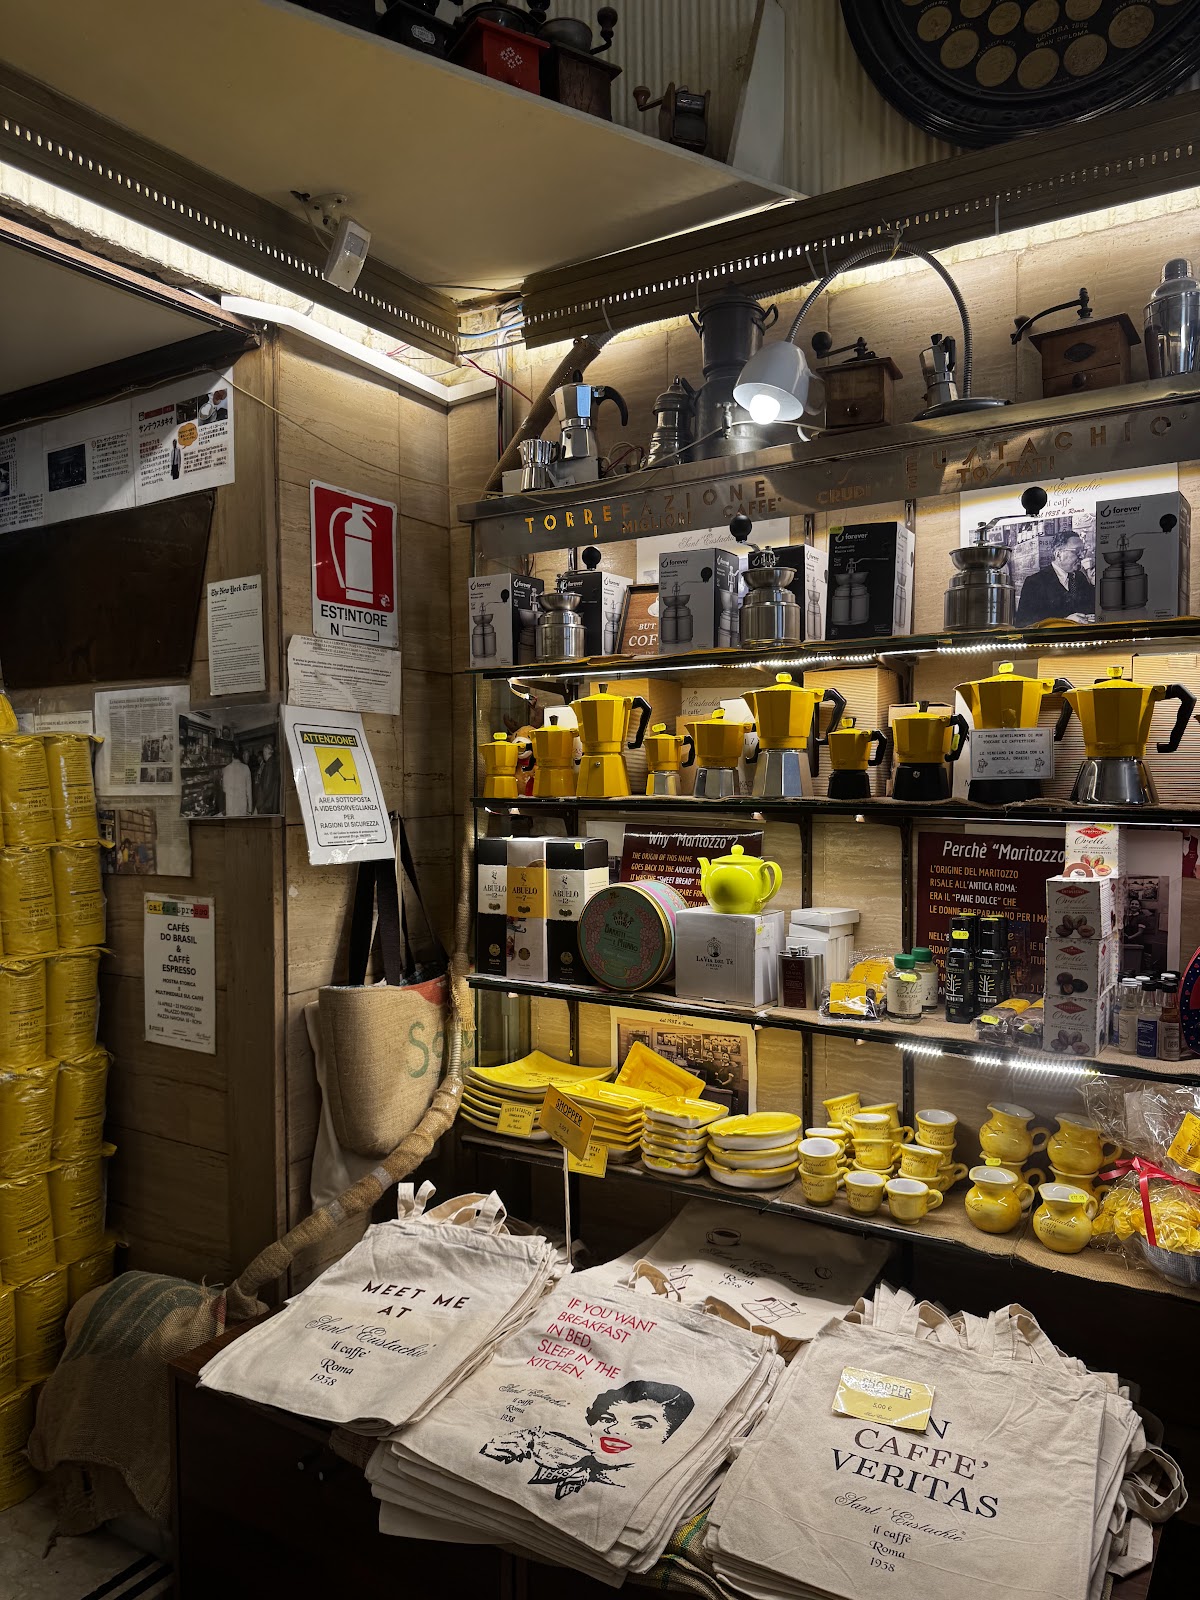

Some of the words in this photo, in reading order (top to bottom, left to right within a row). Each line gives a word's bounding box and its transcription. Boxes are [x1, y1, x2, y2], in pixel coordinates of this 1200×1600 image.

[524, 479, 767, 534] TORREFAZIONE
[905, 415, 1172, 474] EUSTACHIO
[621, 511, 692, 534] MIGLIORI
[816, 485, 872, 505] CRUDI
[956, 455, 1056, 484] TOSTATI
[1113, 506, 1141, 515] forever
[845, 532, 868, 540] forever
[210, 589, 220, 597] The
[219, 587, 230, 595] New
[230, 585, 242, 594] York
[242, 583, 258, 592] Times
[567, 579, 584, 588] forever
[320, 603, 388, 628] ESTINTORE
[330, 623, 340, 636] N
[638, 622, 656, 631] BUT
[628, 634, 659, 648] COF
[303, 732, 357, 746] ATTENZIONE!
[320, 804, 379, 812] VIDEOSORVEGLIANZA
[649, 831, 670, 849] Why
[1074, 835, 1105, 845] Ovelli
[942, 840, 988, 859] Perchè
[631, 851, 641, 860] THE
[641, 852, 659, 861] ORIGIN
[659, 853, 665, 861] OF
[666, 854, 678, 862] THIS
[678, 855, 693, 863] NAME
[631, 862, 643, 871] GOES
[644, 863, 657, 872] BACK
[658, 864, 664, 872] TO
[664, 864, 675, 872] THE
[674, 865, 695, 874] ANCIENT
[930, 864, 963, 876] L'ORIGINE
[964, 866, 977, 876] DEL
[978, 867, 1019, 879] MARITOZZO
[483, 884, 507, 892] ABUELO
[512, 886, 538, 895] ABUELO
[929, 878, 953, 889] RISALE
[954, 879, 993, 891] ALL'ANTICA
[994, 882, 1018, 893] ROMA:
[552, 890, 579, 898] ABUELO
[929, 891, 943, 901] ERA
[944, 893, 951, 901] IL
[1002, 897, 1017, 907] CHE
[929, 904, 938, 914] LE
[938, 905, 961, 916] DONNE
[1016, 911, 1031, 922] PER
[1032, 913, 1036, 922] I
[1036, 914, 1048, 923] MA
[167, 922, 190, 933] CAFÉS
[160, 932, 171, 941] DO
[172, 933, 198, 944] BRASIL
[176, 945, 181, 953] &
[168, 954, 190, 965] CAFFÈ
[162, 964, 197, 976] ESPRESSO
[555, 1098, 583, 1128] SHOPPER
[361, 1280, 426, 1300] MEET
[432, 1293, 471, 1310] ME
[377, 1305, 413, 1319] AT
[567, 1297, 582, 1310] IF
[583, 1302, 613, 1320] YOU
[614, 1312, 658, 1334] WANT
[557, 1311, 632, 1344] BREAKFAST
[546, 1323, 563, 1338] IN
[564, 1332, 594, 1353] BED,
[330, 1340, 339, 1351] il
[537, 1338, 575, 1359] SLEEP
[574, 1352, 594, 1367] IN
[594, 1360, 622, 1380] THE
[320, 1358, 355, 1376] Roma
[526, 1355, 584, 1381] KITCHEN.
[309, 1372, 338, 1387] 1938
[505, 1404, 525, 1414] Roma
[500, 1413, 516, 1423] 1938
[854, 1428, 989, 1481] CAFFE'
[831, 1448, 999, 1519] VERITAS
[890, 1507, 966, 1543] Eustachio
[872, 1524, 880, 1534] il
[883, 1529, 912, 1546] caffè
[869, 1540, 906, 1559] Roma
[869, 1556, 896, 1573] 1938
